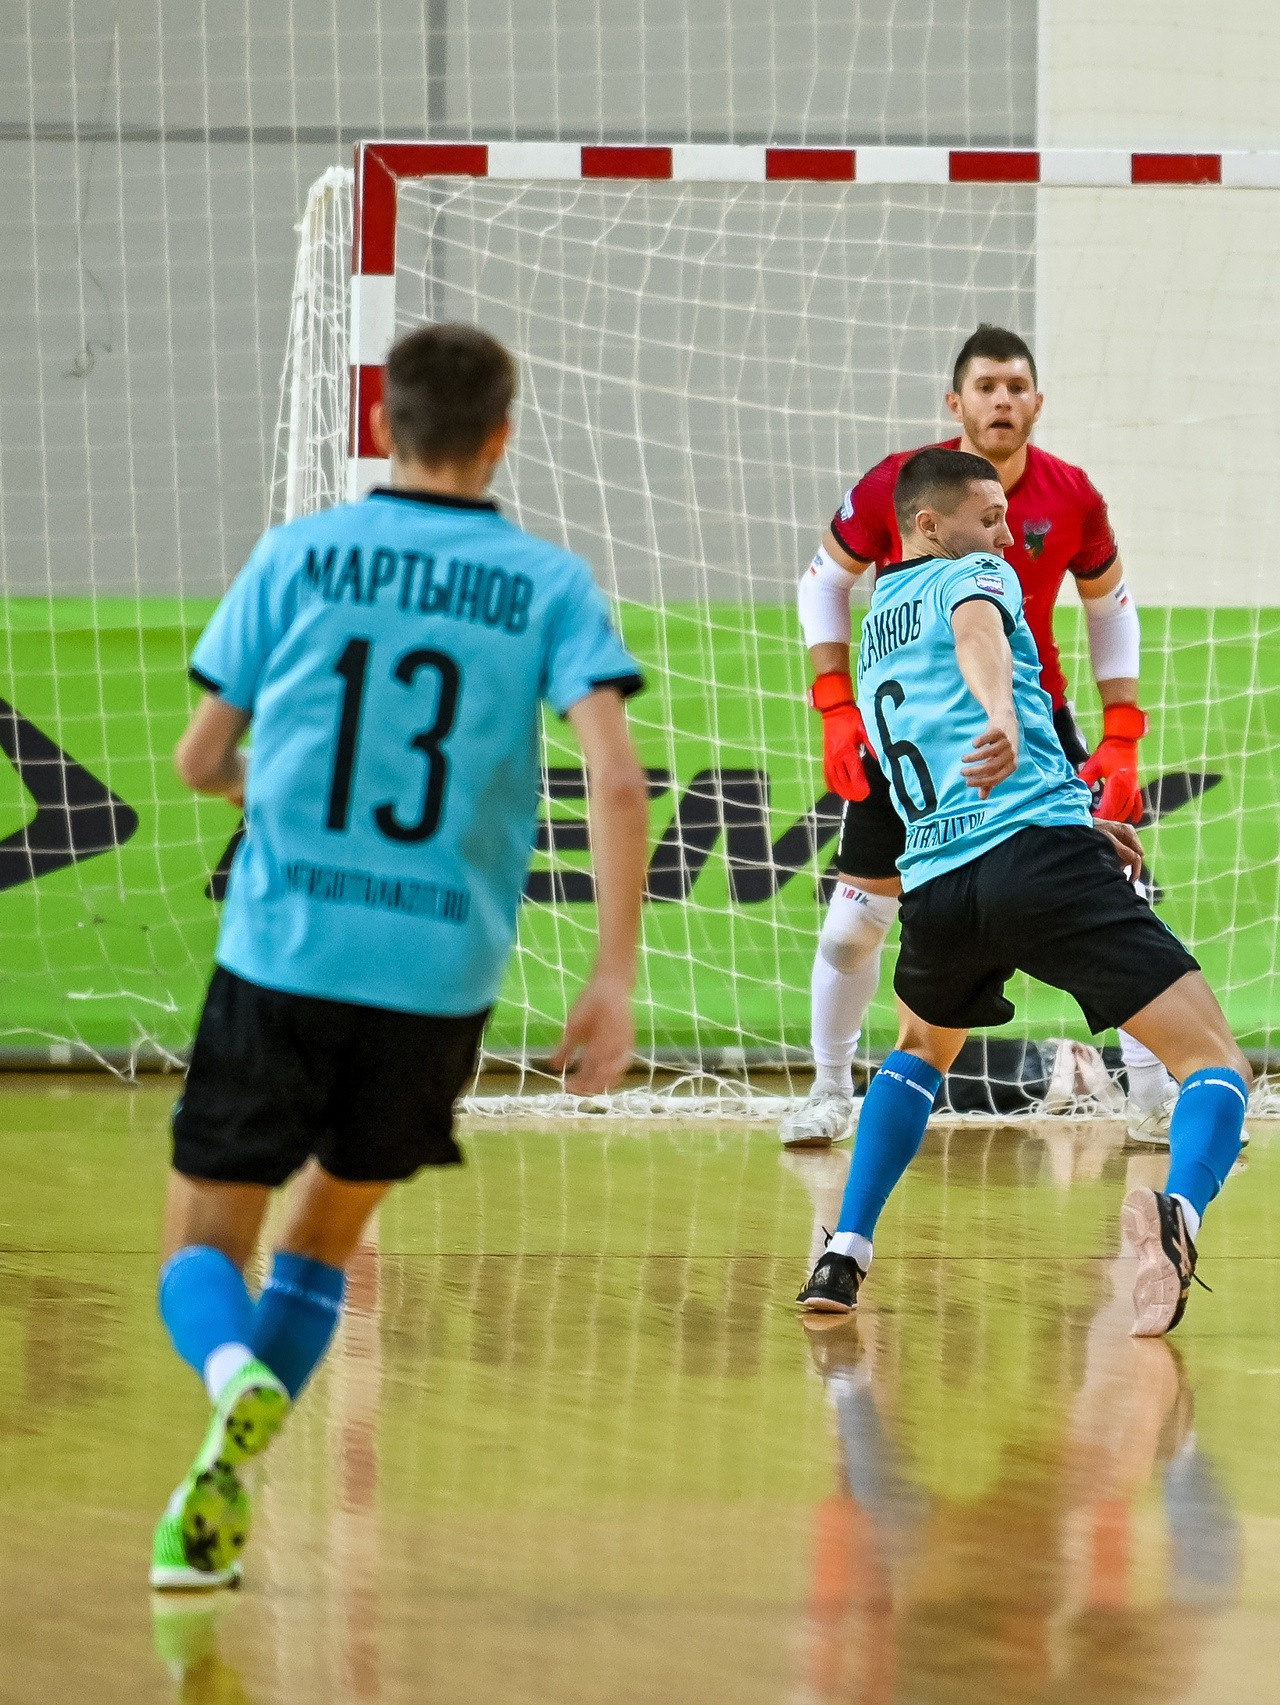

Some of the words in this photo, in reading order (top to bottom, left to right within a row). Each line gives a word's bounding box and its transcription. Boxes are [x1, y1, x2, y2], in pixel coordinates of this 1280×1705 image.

[303, 545, 534, 635] МАРТЫНОВ
[325, 637, 463, 843] 13
[874, 680, 939, 823] 6
